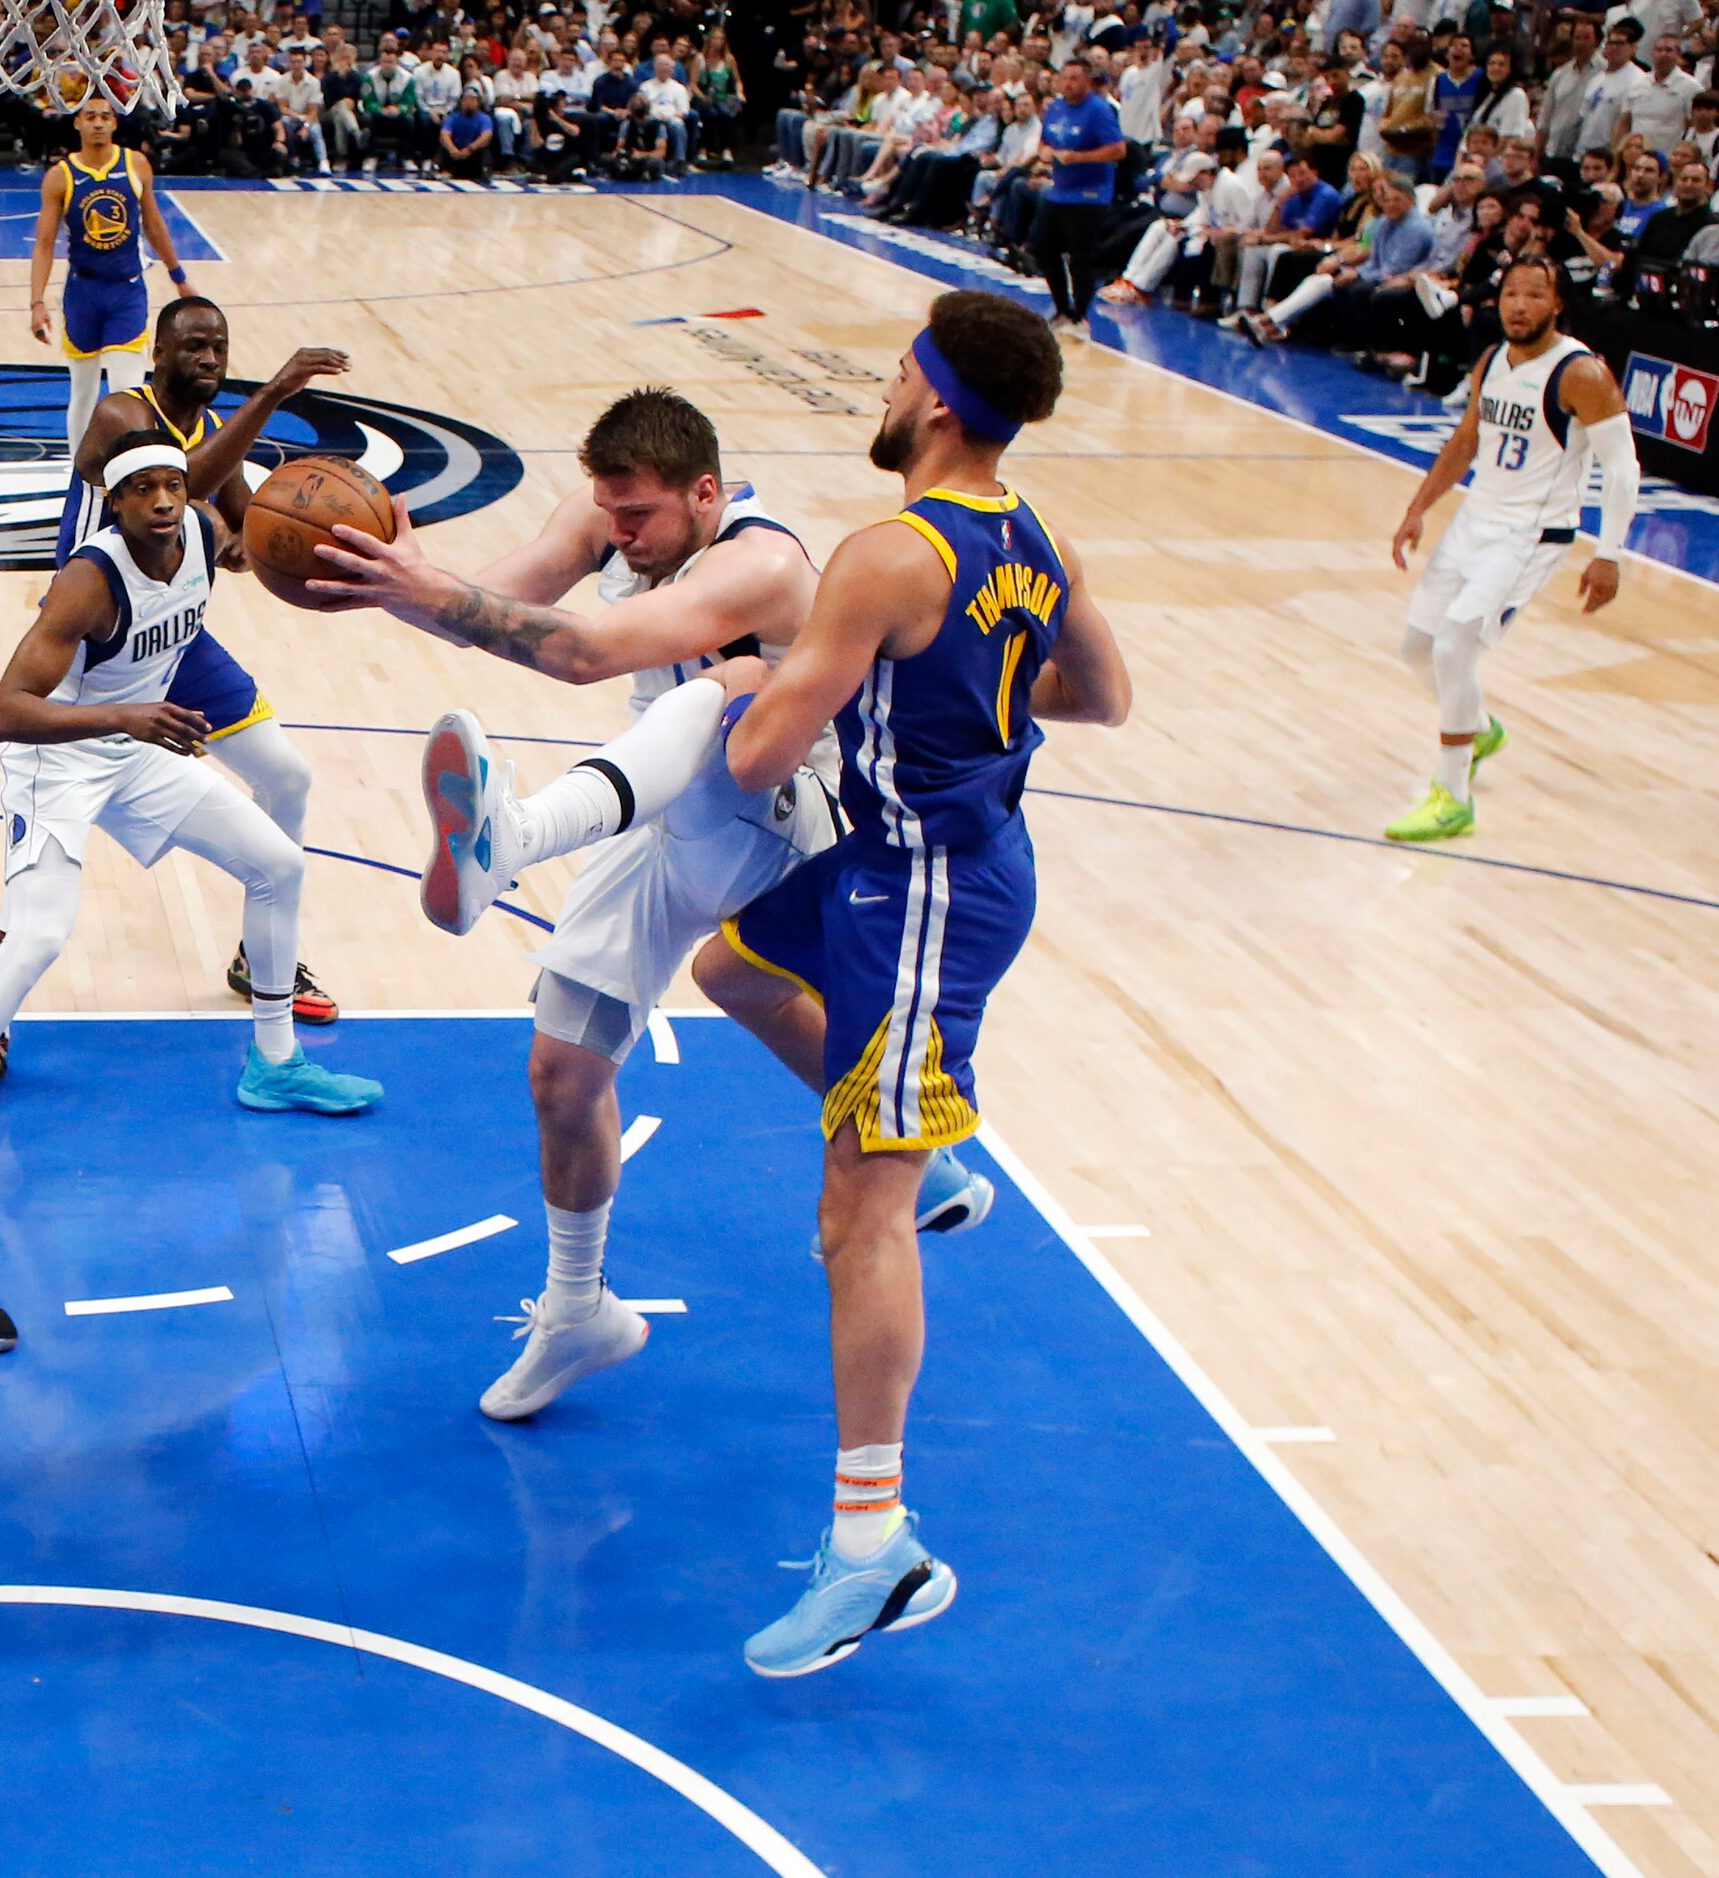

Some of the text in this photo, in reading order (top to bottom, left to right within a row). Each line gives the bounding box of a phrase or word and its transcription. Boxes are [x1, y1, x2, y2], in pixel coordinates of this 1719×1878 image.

[111, 205, 121, 219] 3
[1480, 397, 1536, 432] DALLAS
[1626, 368, 1661, 419] NBA
[1495, 431, 1530, 472] 13
[964, 562, 1062, 636] THMPSON
[131, 600, 207, 664] DALLAS
